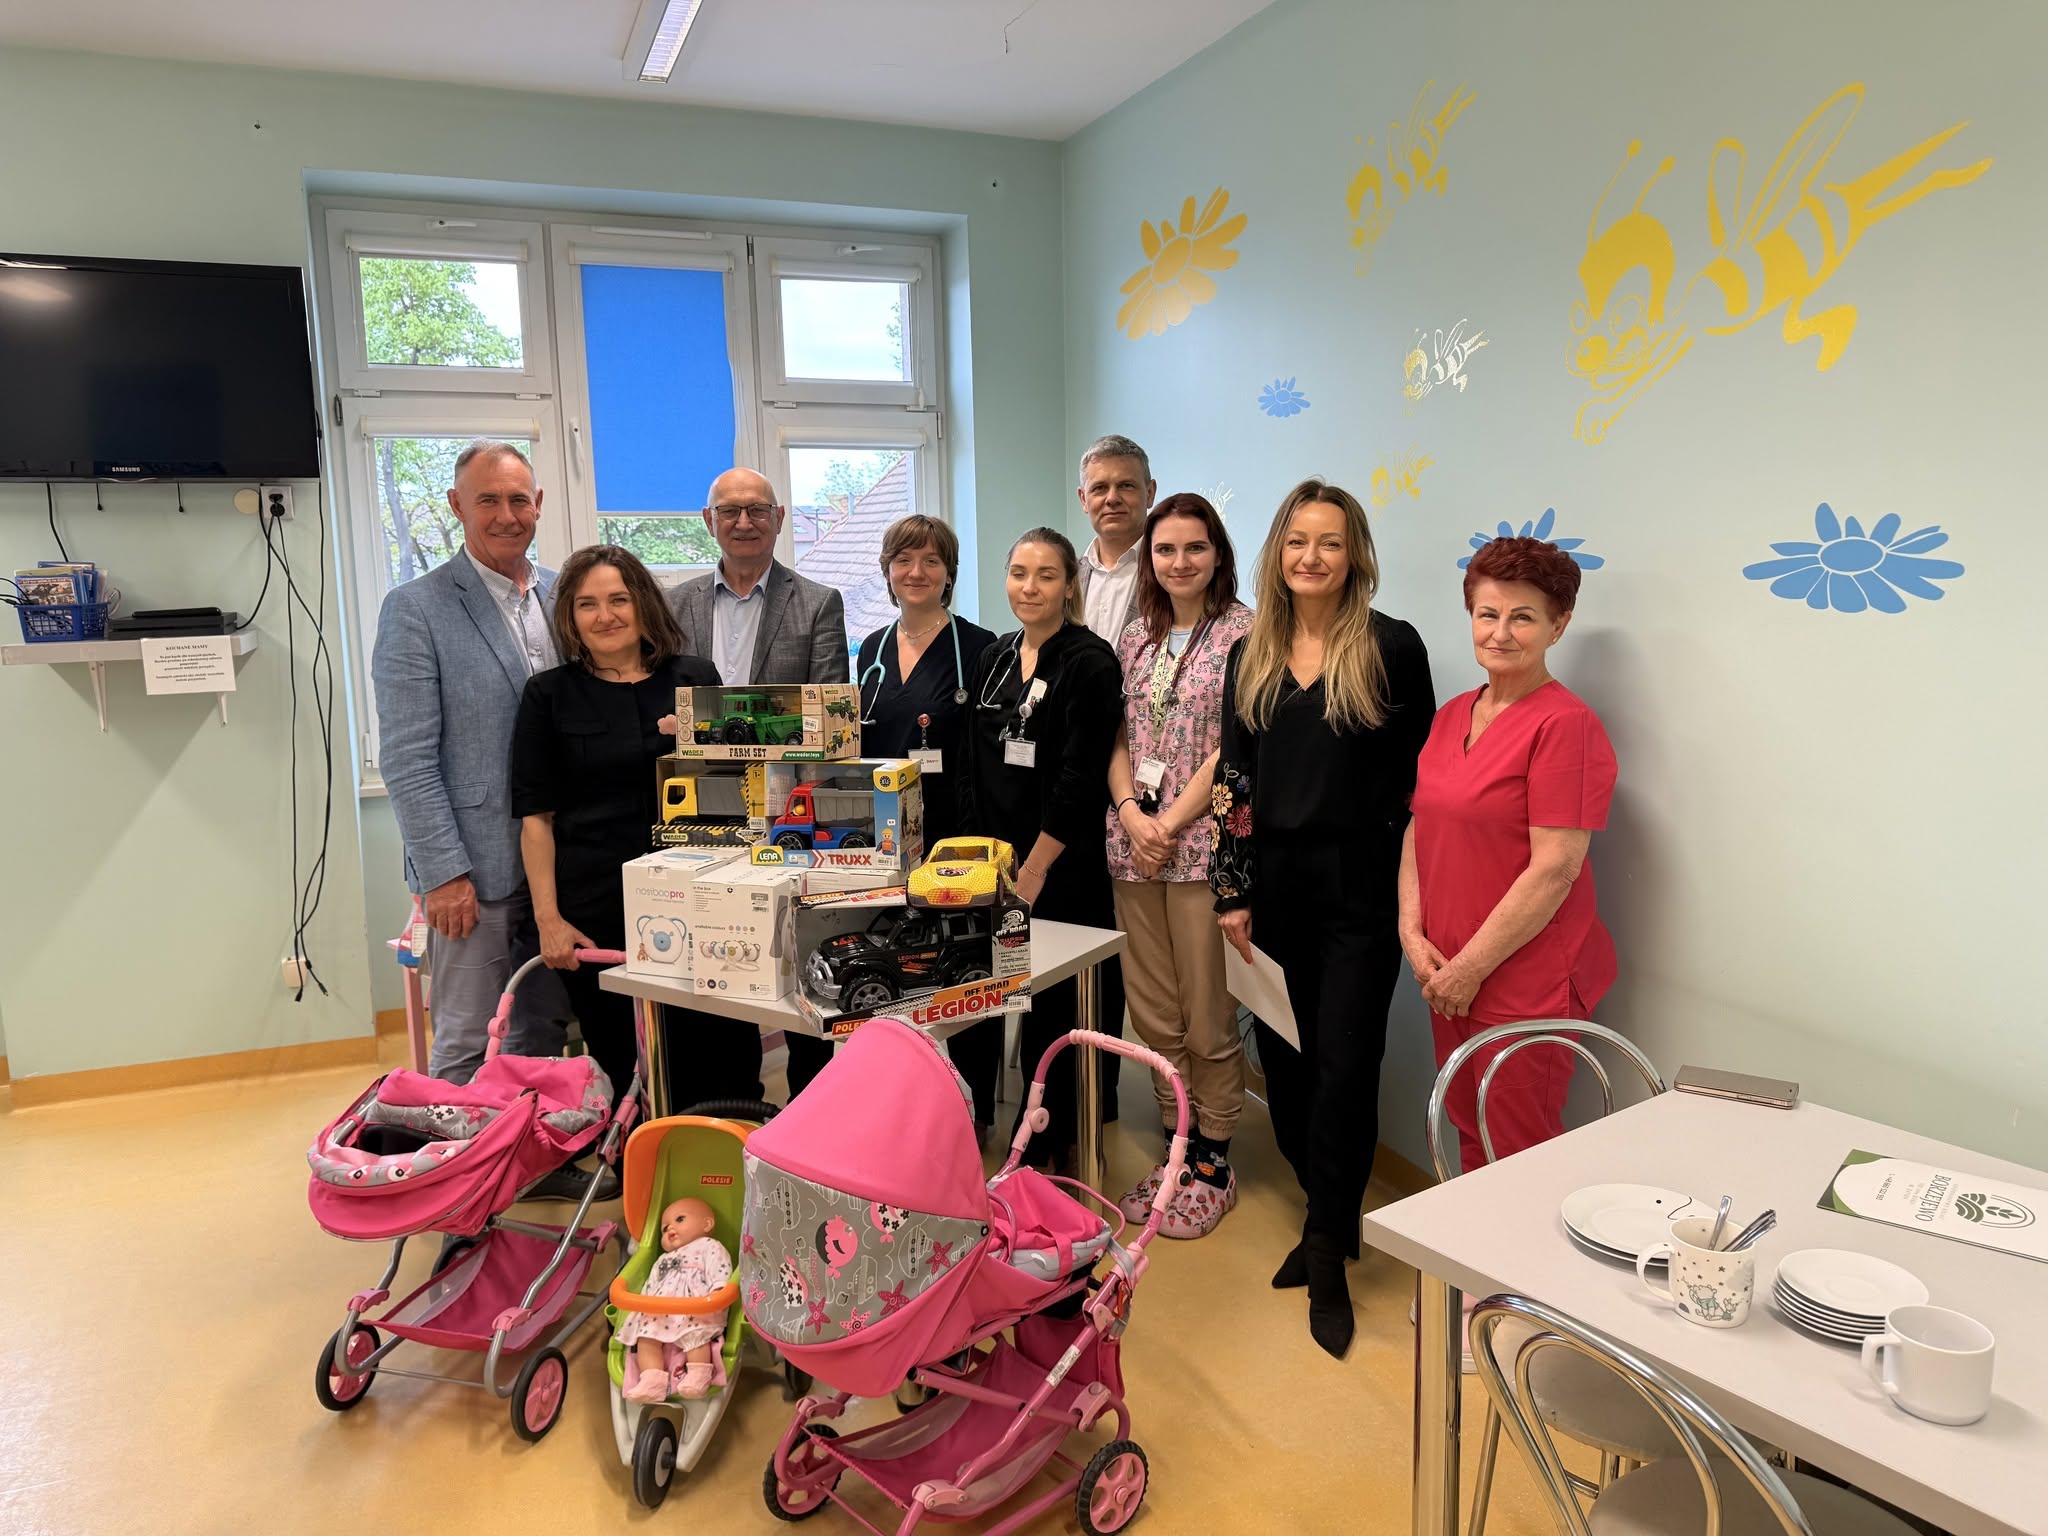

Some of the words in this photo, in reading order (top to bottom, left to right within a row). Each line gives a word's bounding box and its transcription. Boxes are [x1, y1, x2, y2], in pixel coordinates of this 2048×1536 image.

[729, 748, 750, 758] FARM
[752, 748, 767, 758] SET
[759, 852, 778, 860] LENA
[827, 853, 872, 865] TRUXX
[996, 929, 1007, 937] OFF
[1010, 924, 1028, 933] ROAD
[964, 986, 981, 997] OFF
[984, 980, 1009, 992] ROAD
[912, 990, 1002, 1025] LEGION
[702, 1176, 731, 1184] POLESIE
[1915, 1174, 1952, 1221] BORZEJEWO
